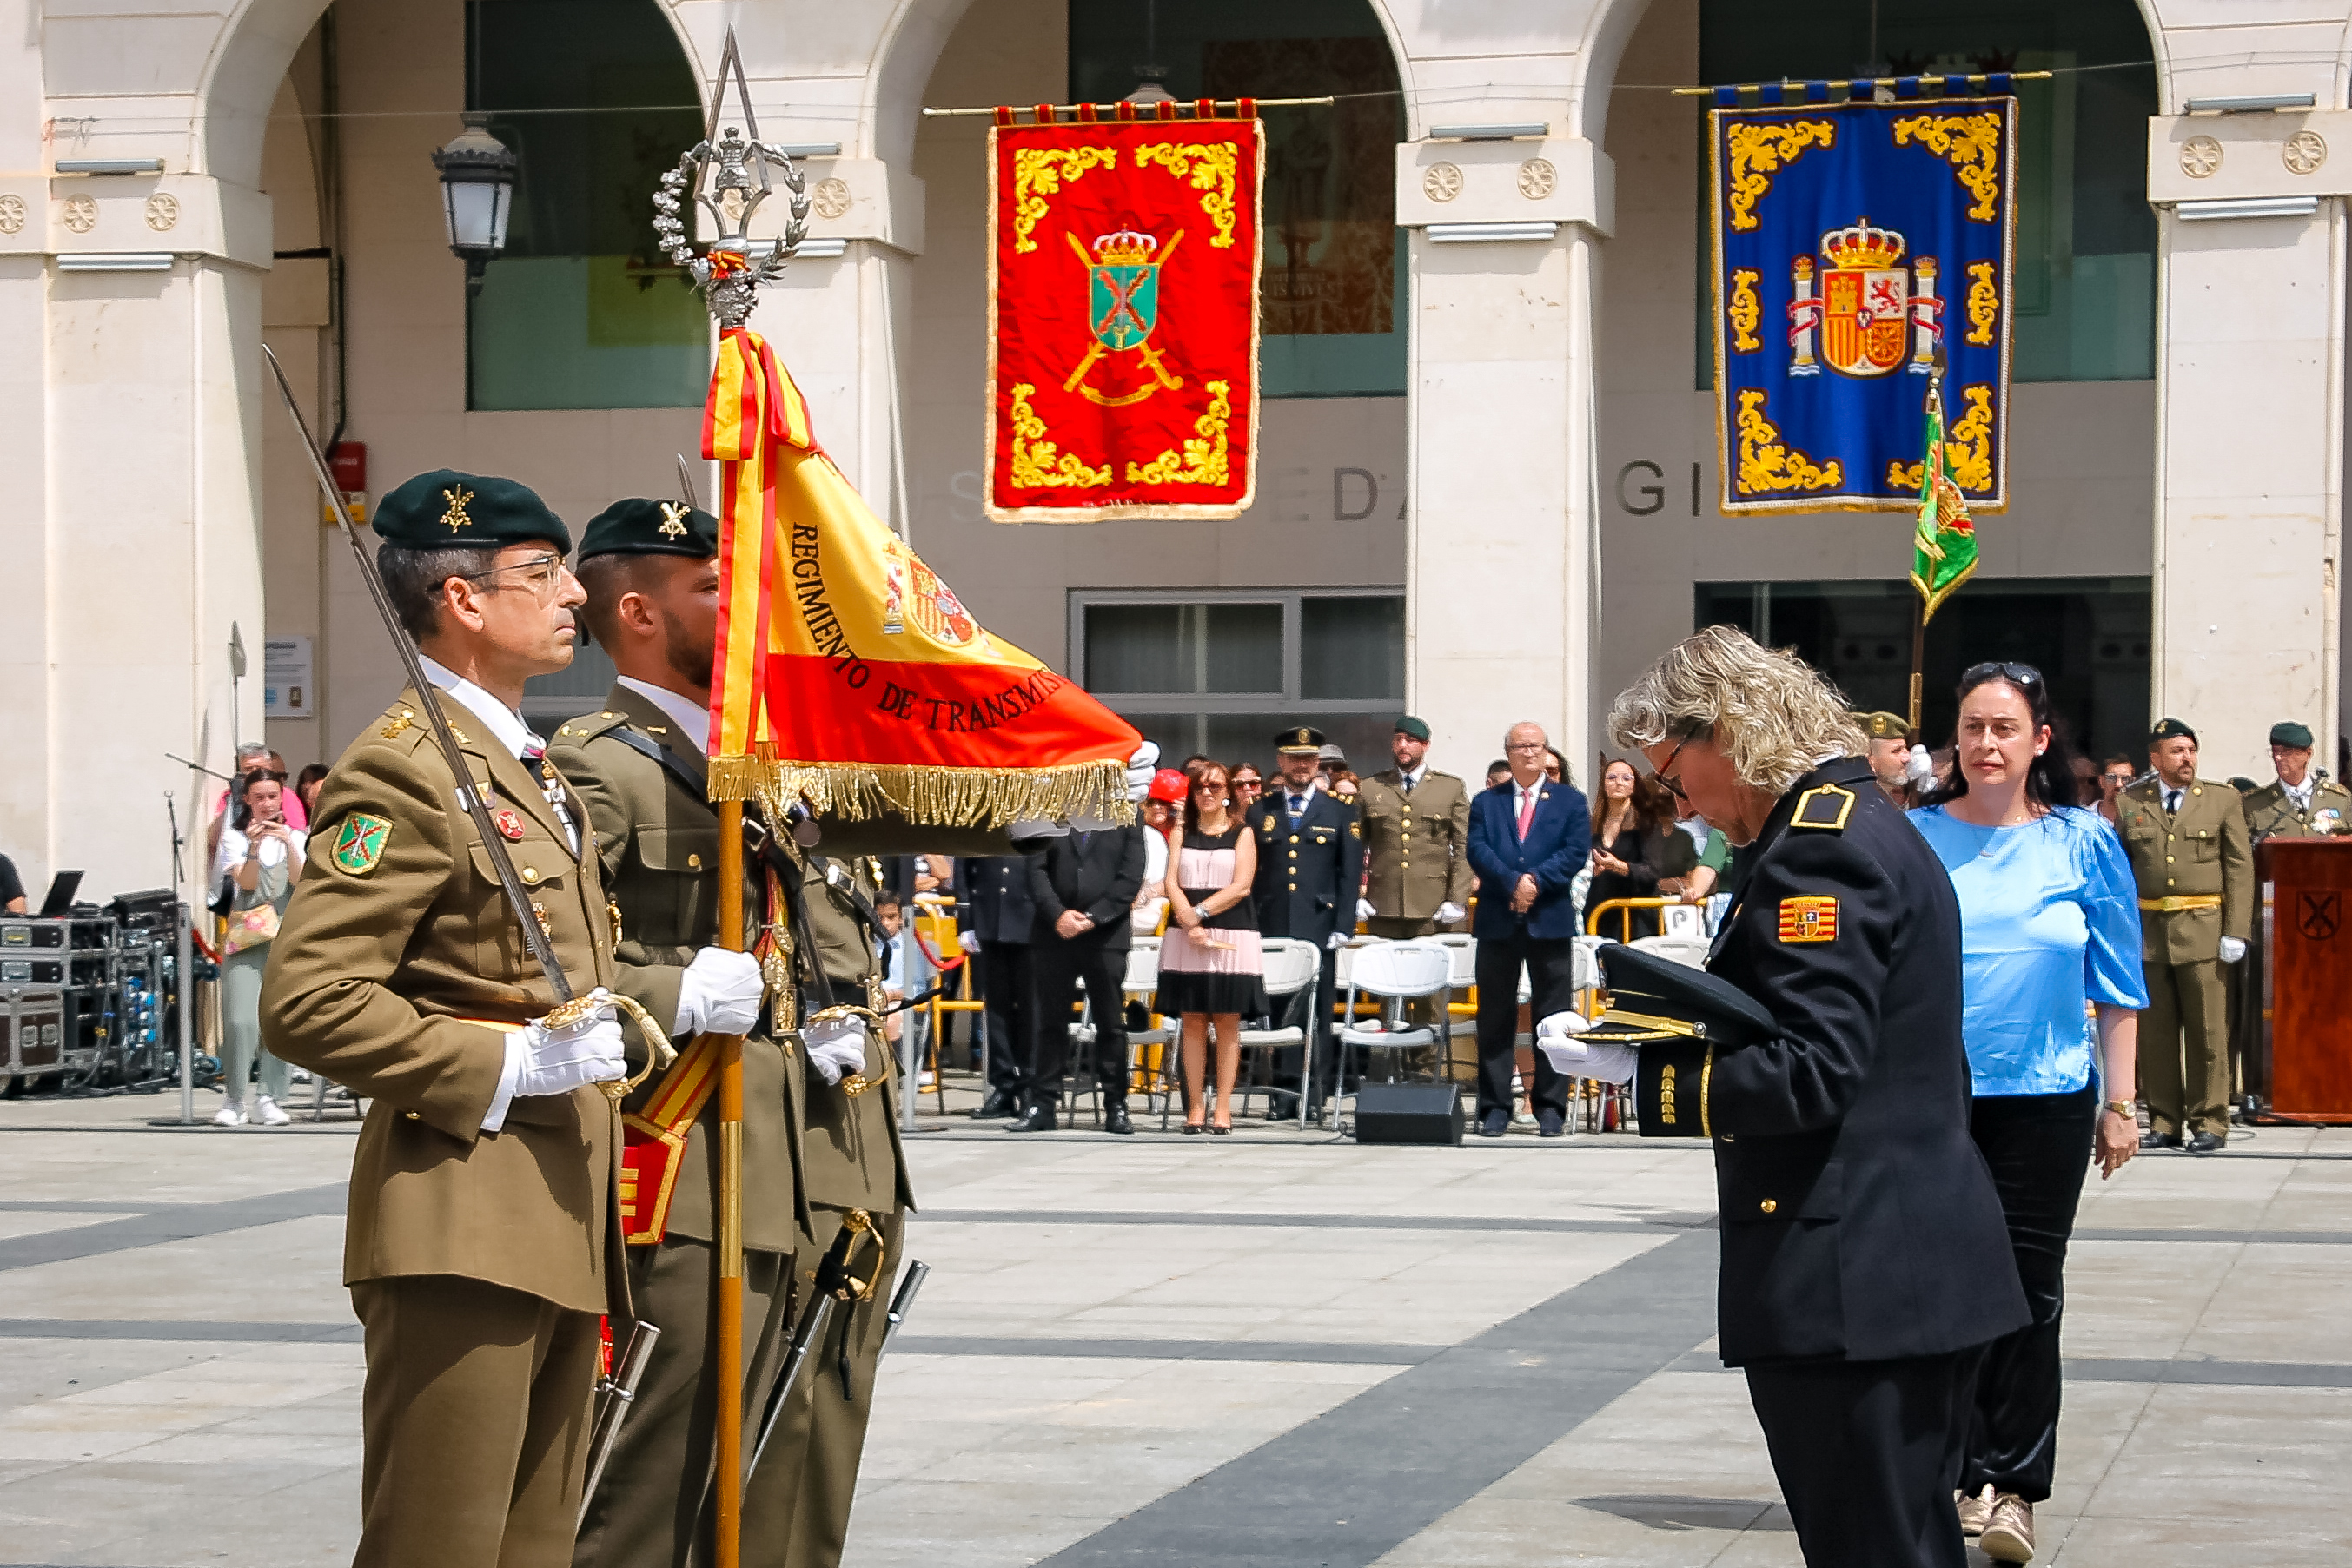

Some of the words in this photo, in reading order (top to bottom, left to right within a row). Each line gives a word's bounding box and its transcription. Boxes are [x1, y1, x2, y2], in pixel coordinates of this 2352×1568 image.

[791, 521, 871, 690] REGIMIENTO
[875, 681, 918, 720] DE
[924, 666, 1068, 732] TRANSMIS
